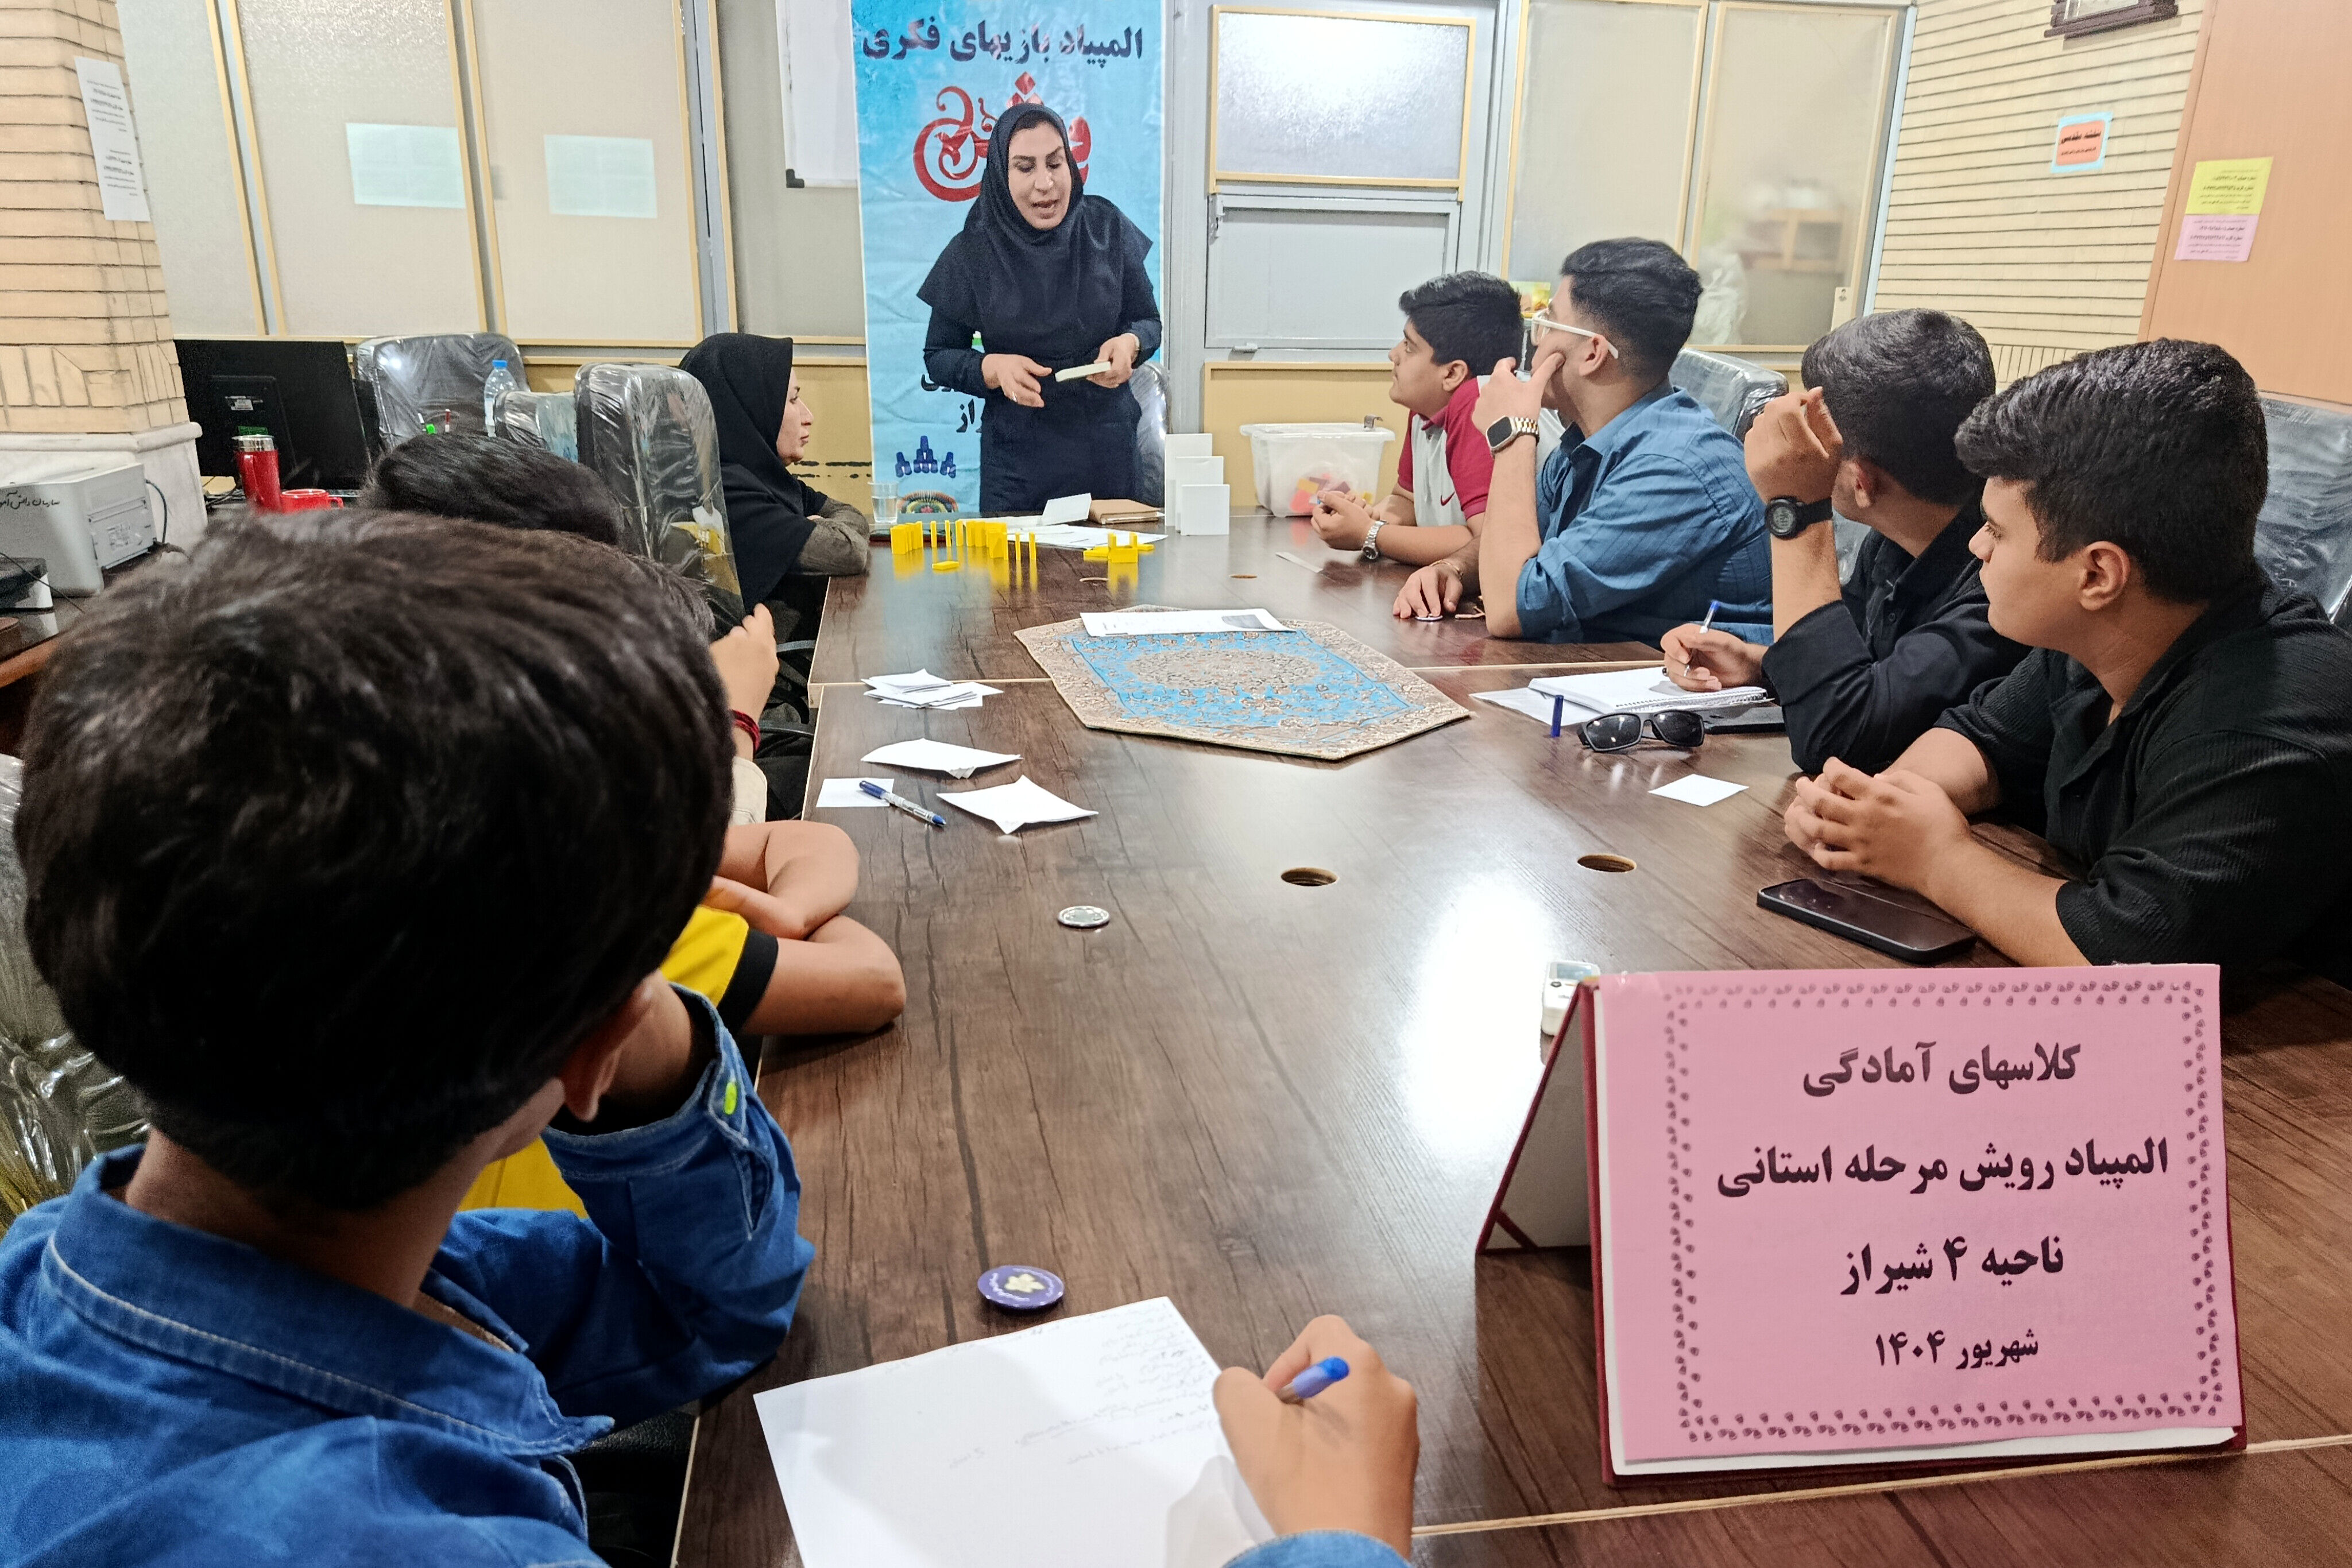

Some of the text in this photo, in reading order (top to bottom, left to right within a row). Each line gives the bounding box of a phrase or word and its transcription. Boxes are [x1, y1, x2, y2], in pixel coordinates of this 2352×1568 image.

[863, 16, 1143, 69] المپیاد بازیهای فکری
[1803, 1041, 2081, 1097] کلاسهای آمادگی
[1717, 1136, 2168, 1198] المپیاد رویش مرحله استانی
[1840, 1236, 2064, 1295] ناحیه ۴ شیراز
[1875, 1328, 2038, 1370] شهریور ۱۴۰۴
